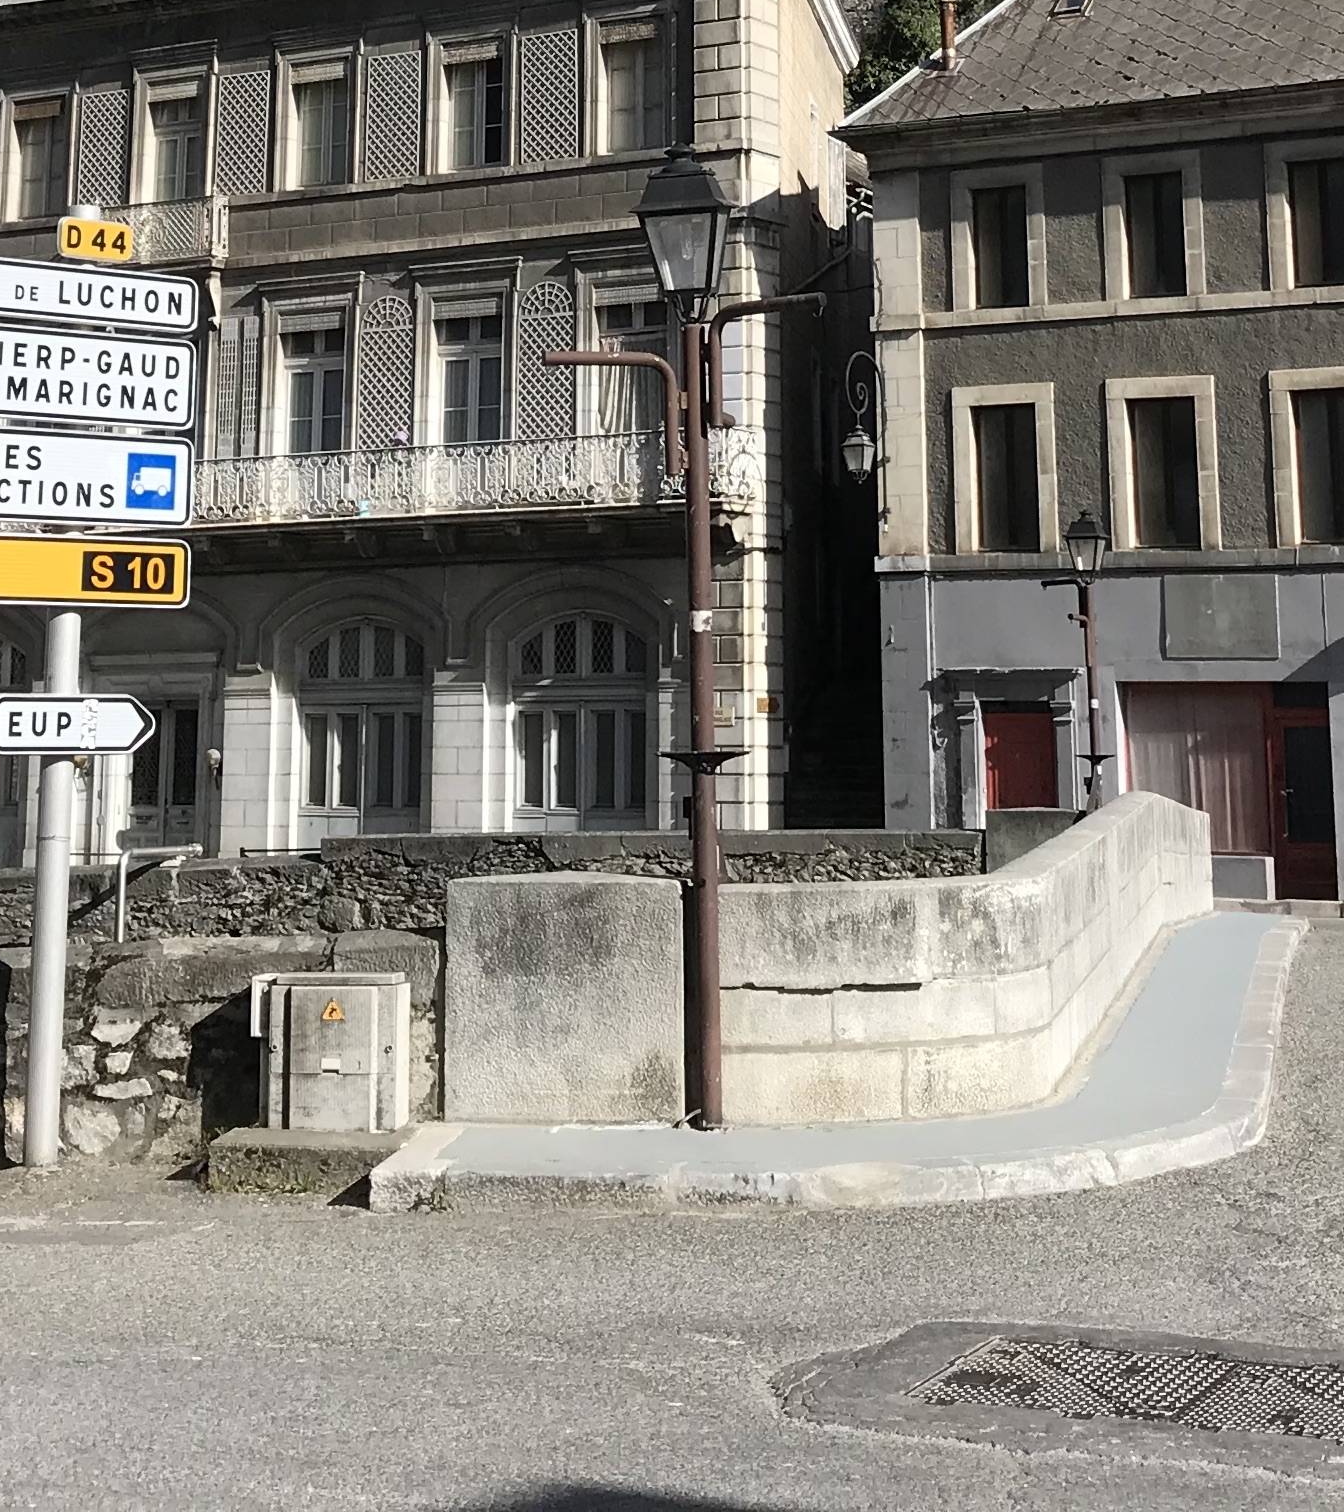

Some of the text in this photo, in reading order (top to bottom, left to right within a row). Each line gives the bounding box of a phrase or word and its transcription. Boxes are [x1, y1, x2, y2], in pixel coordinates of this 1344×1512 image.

[66, 225, 127, 255] D 44
[14, 285, 40, 303] DE
[58, 279, 184, 317] LUCHON
[6, 375, 179, 413] MARIGNAC
[90, 554, 167, 591] S 10
[8, 711, 72, 738] EUP
